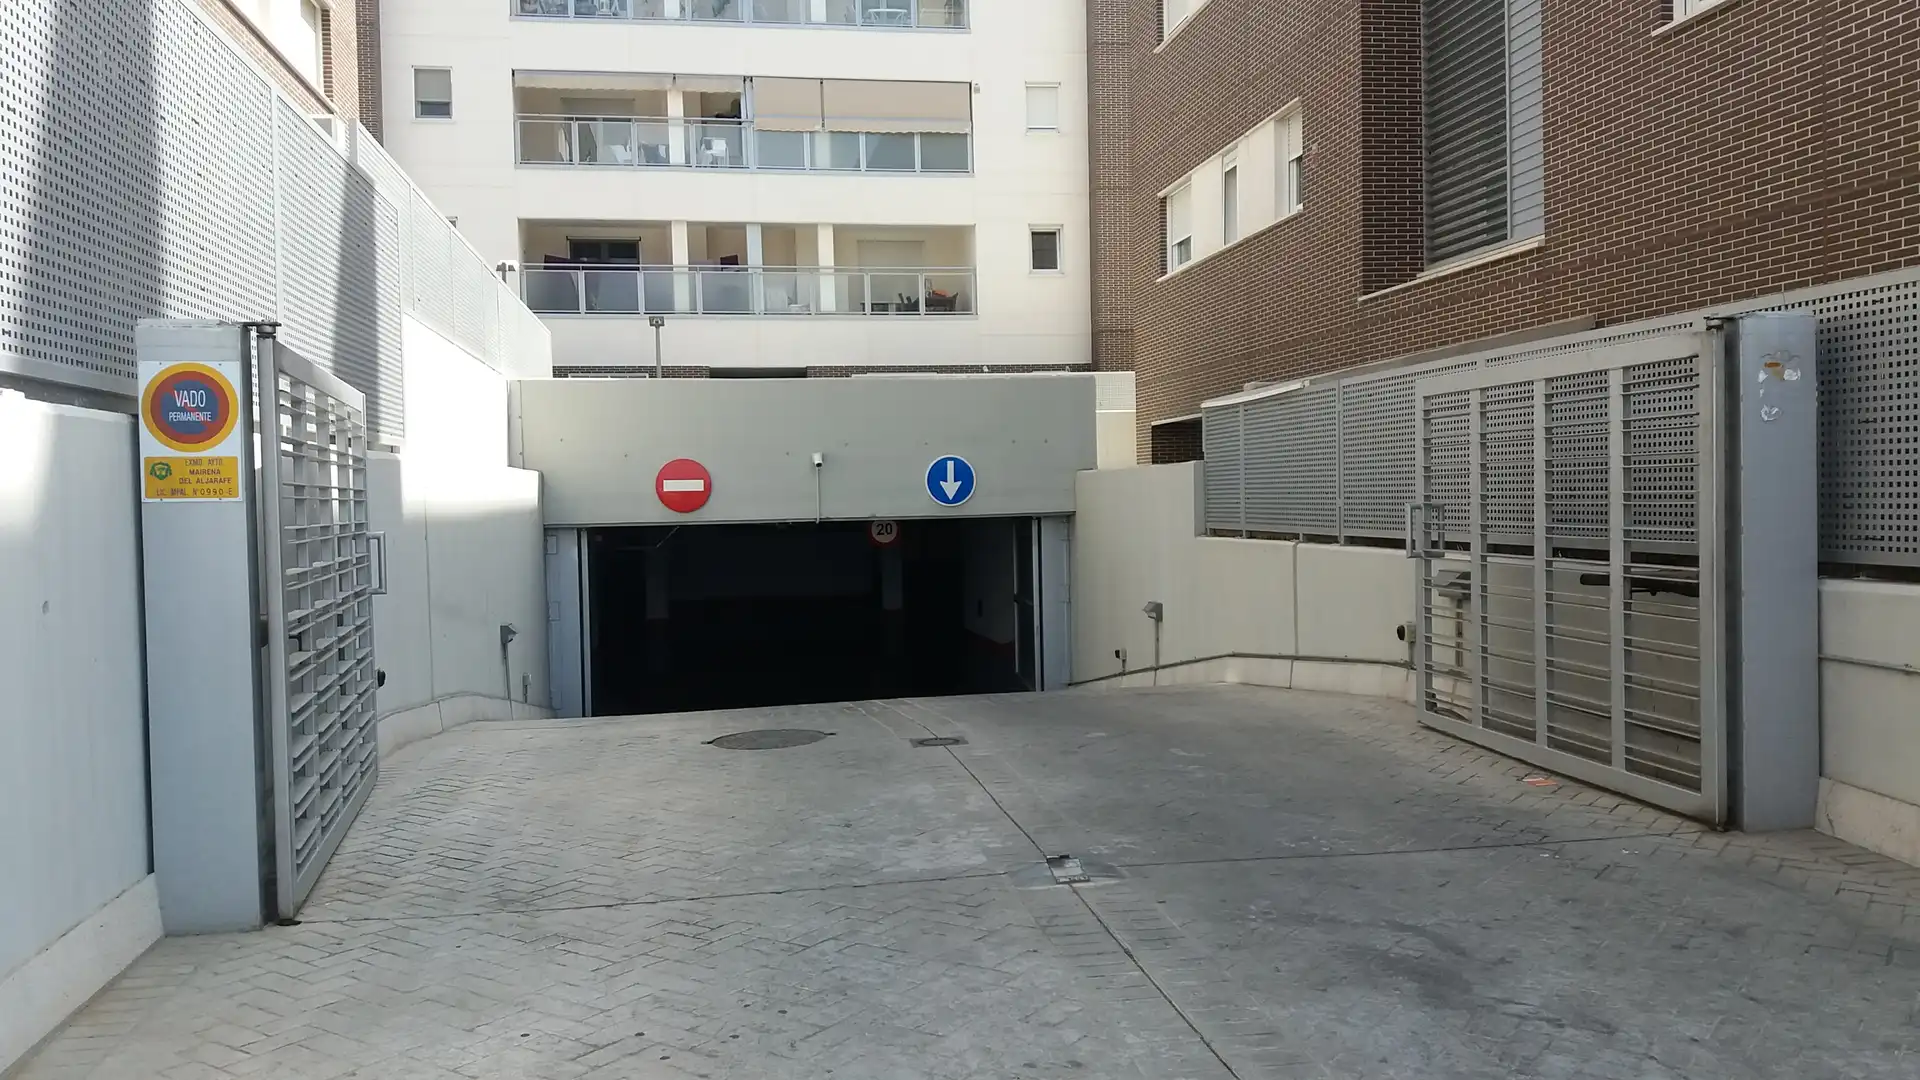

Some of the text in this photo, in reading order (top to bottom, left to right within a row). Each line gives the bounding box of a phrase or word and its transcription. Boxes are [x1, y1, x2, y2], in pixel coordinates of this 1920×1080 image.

[174, 390, 206, 407] VADO
[168, 411, 212, 422] PERMANENTE
[178, 477, 232, 485] DEL ALJARAFE
[876, 522, 893, 536] 20
